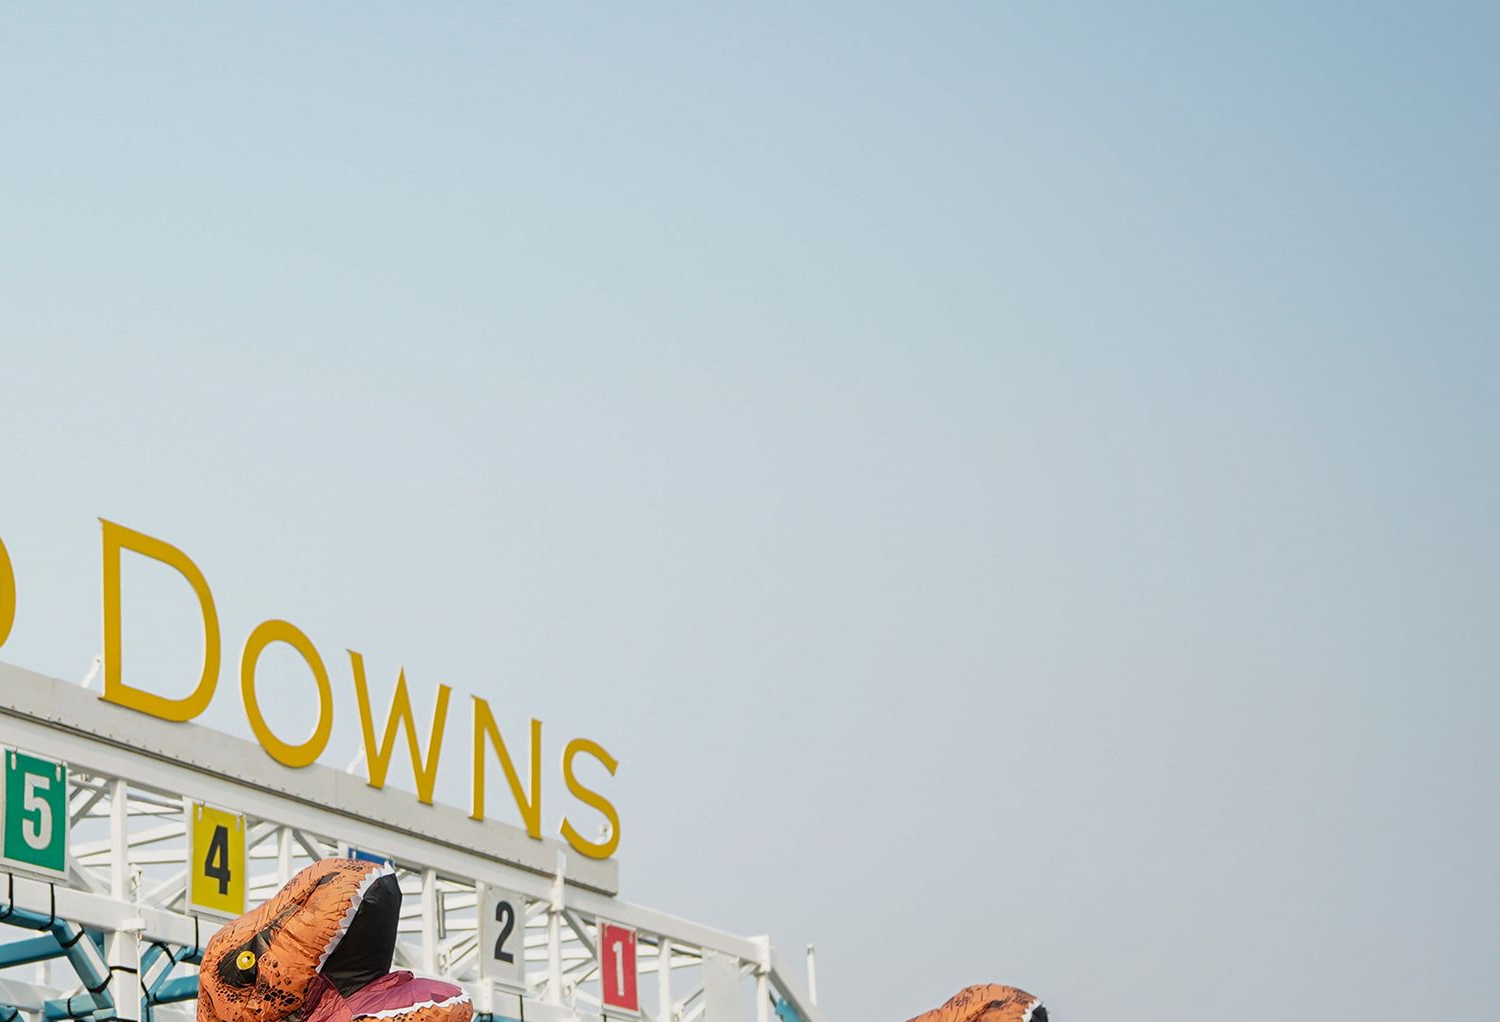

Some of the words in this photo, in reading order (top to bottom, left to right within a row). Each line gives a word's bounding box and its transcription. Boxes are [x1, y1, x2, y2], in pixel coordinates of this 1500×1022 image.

[98, 516, 621, 860] DOWNS
[22, 772, 53, 850] 5
[203, 825, 232, 895] 4
[493, 900, 517, 964] 2
[612, 939, 626, 997] 1
